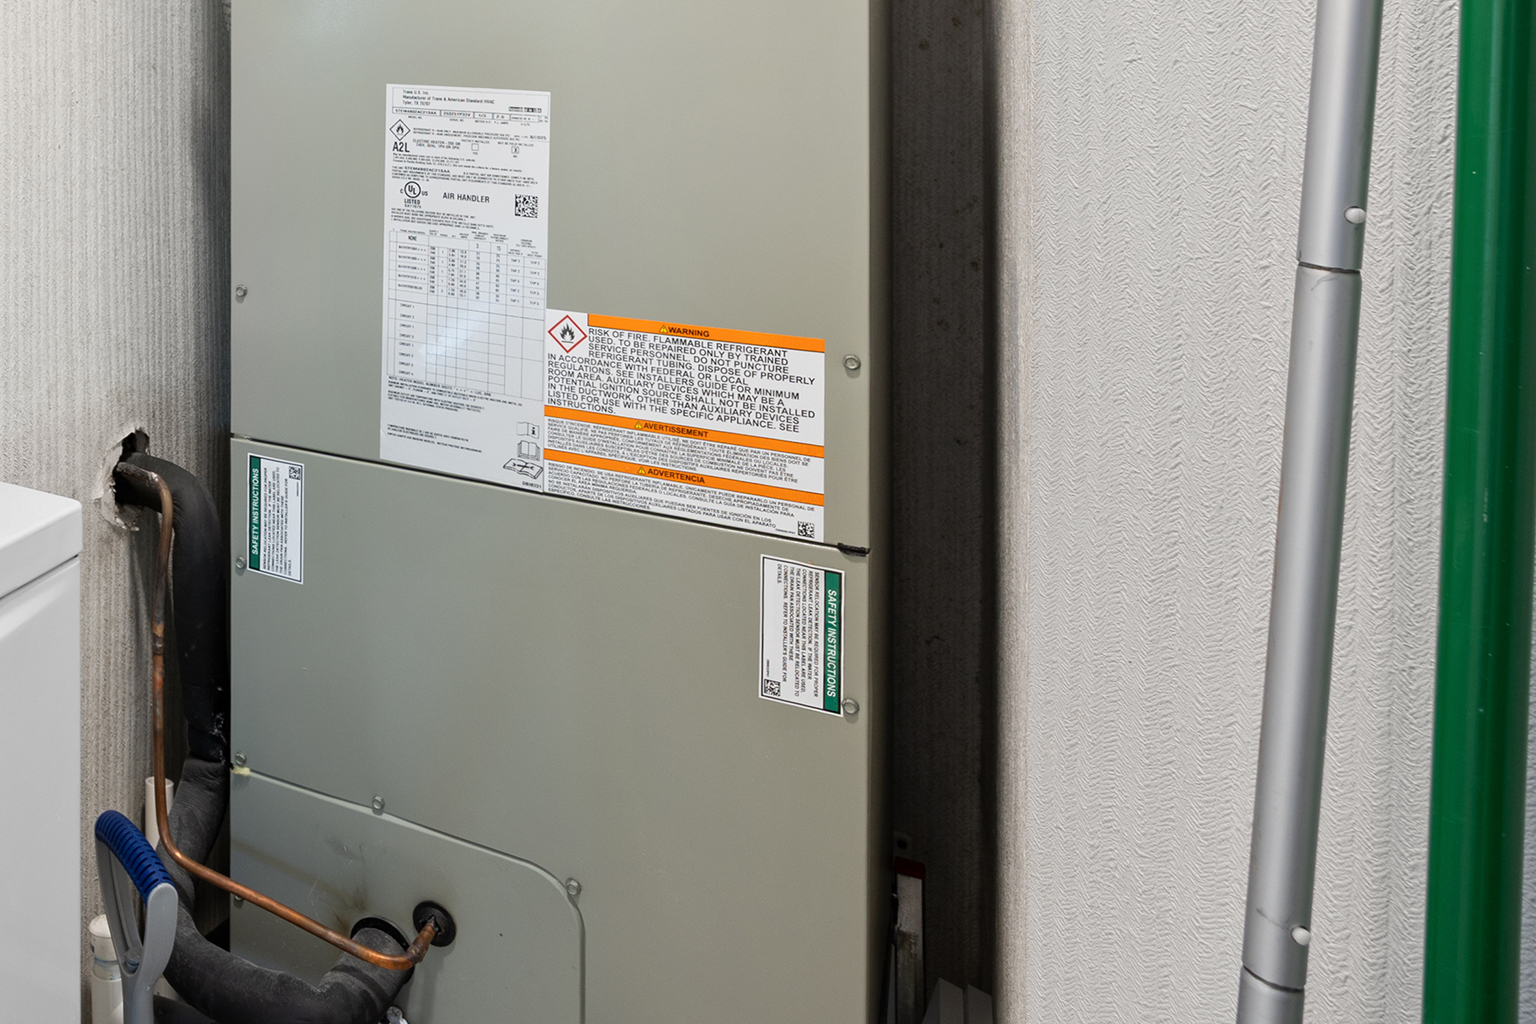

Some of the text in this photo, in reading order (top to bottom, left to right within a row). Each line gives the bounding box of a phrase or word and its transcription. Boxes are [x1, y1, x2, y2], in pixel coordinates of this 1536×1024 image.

[392, 142, 410, 153] A2L
[408, 185, 417, 195] UL
[443, 192, 490, 203] AIR HANDLER
[588, 327, 788, 358] RISK OF FIRE. FLAMMABLE REFRIGERANT
[669, 327, 709, 338] WARNING
[588, 335, 788, 366] USED. TO BE REPAIRED ONLY BY TRAINED
[588, 343, 789, 375] SERVICE PERSONNEL. DO NOT PUNCTURE
[548, 360, 799, 400] REGULATIONS. SEE INSTALLERS GUIDE FOR MINIMUM
[558, 354, 622, 369] ACCORDANCE
[624, 363, 648, 372] WITH
[651, 366, 695, 379] FEDERAL
[697, 372, 712, 381] OR
[715, 374, 748, 386] LOCAL
[588, 350, 815, 386] REFRIGERANT TUBING. DISPOSE OF PROPERLY
[548, 368, 574, 378] ROOM
[606, 375, 655, 389] AUXILIARY
[658, 382, 699, 395] DEVICES
[701, 388, 734, 400] WHICH
[737, 393, 758, 403] MAY
[761, 396, 774, 405] BE
[777, 398, 785, 406] A
[548, 375, 815, 419] POTENTIAL IGNITION SOURCE SHALL NOT BE INSTALLED
[548, 397, 615, 414] INSTRUCTIONS.
[548, 390, 799, 433] LISTED FOR USE WITH THE SPECIFIC APPLIANCE. SEE
[559, 384, 575, 393] THE
[636, 395, 669, 407] OTHER
[672, 400, 698, 410] THAN
[700, 404, 752, 418] AUXILIARY
[755, 411, 799, 425] DEVICES
[644, 422, 708, 438] AVERTISSEMENT
[648, 468, 705, 483] ADVERTENCIA
[827, 589, 837, 698] SAFETY INSTRUCTIONS
